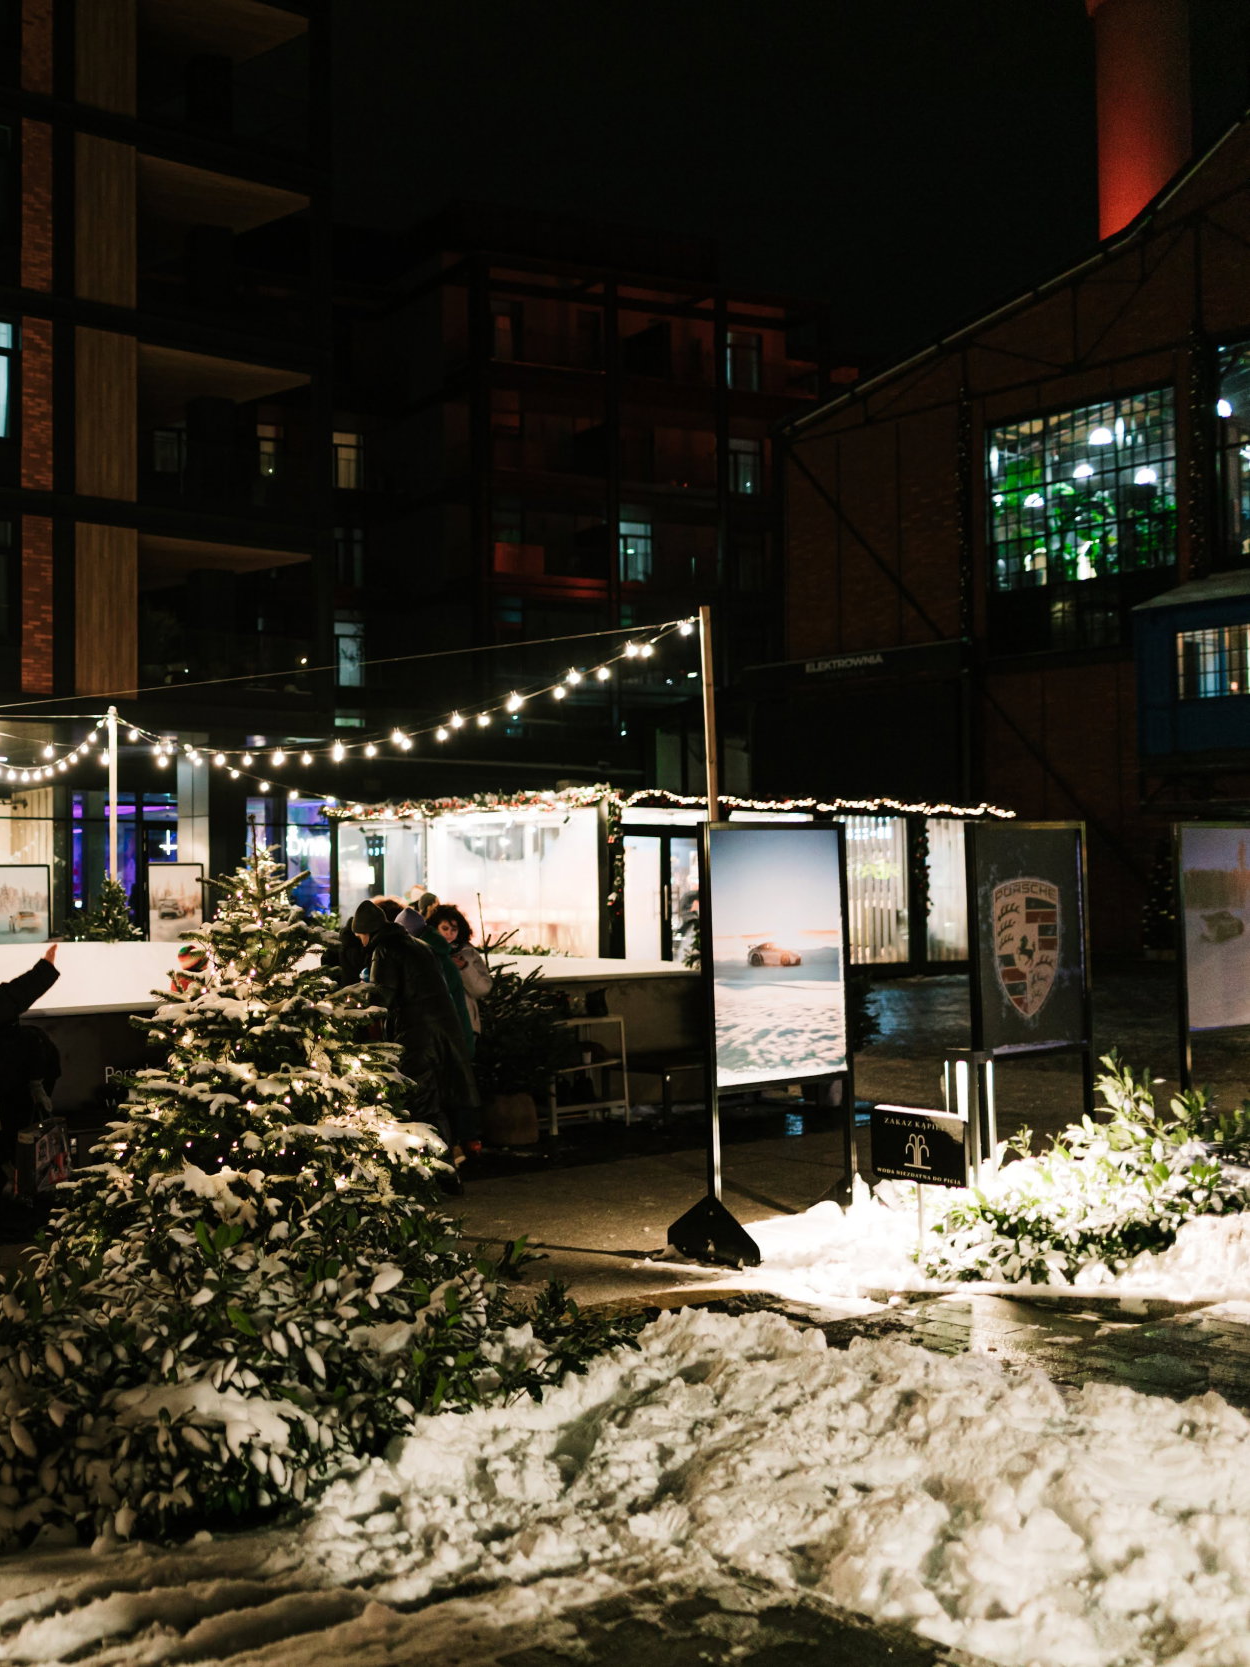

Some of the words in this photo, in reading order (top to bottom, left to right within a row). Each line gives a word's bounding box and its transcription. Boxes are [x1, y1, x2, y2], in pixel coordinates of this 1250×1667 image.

[805, 654, 883, 673] ELEKTROWNIA
[994, 883, 1057, 902] PORSCHE
[884, 1117, 912, 1127] ZAKAZ
[896, 1170, 931, 1180] NIEZDATNA
